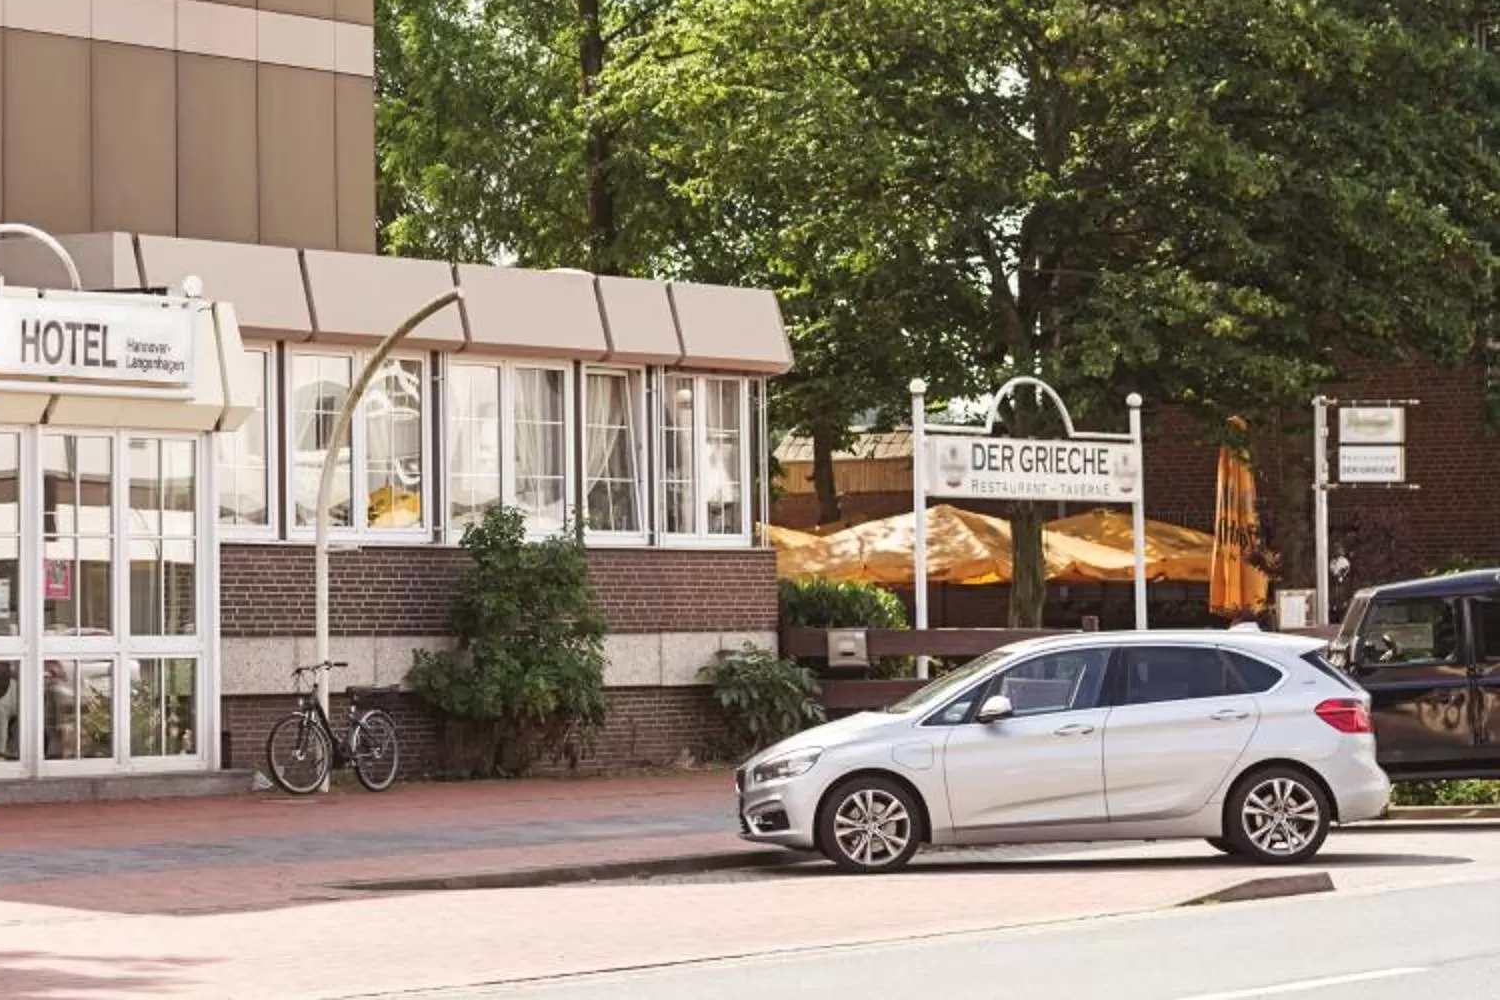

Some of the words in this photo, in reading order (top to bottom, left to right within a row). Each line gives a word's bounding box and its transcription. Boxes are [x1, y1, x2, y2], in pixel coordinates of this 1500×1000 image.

[20, 318, 118, 369] HOTEL
[126, 355, 186, 374] Langenhagen
[971, 442, 1015, 473] DER
[1019, 445, 1110, 476] GRIECHE
